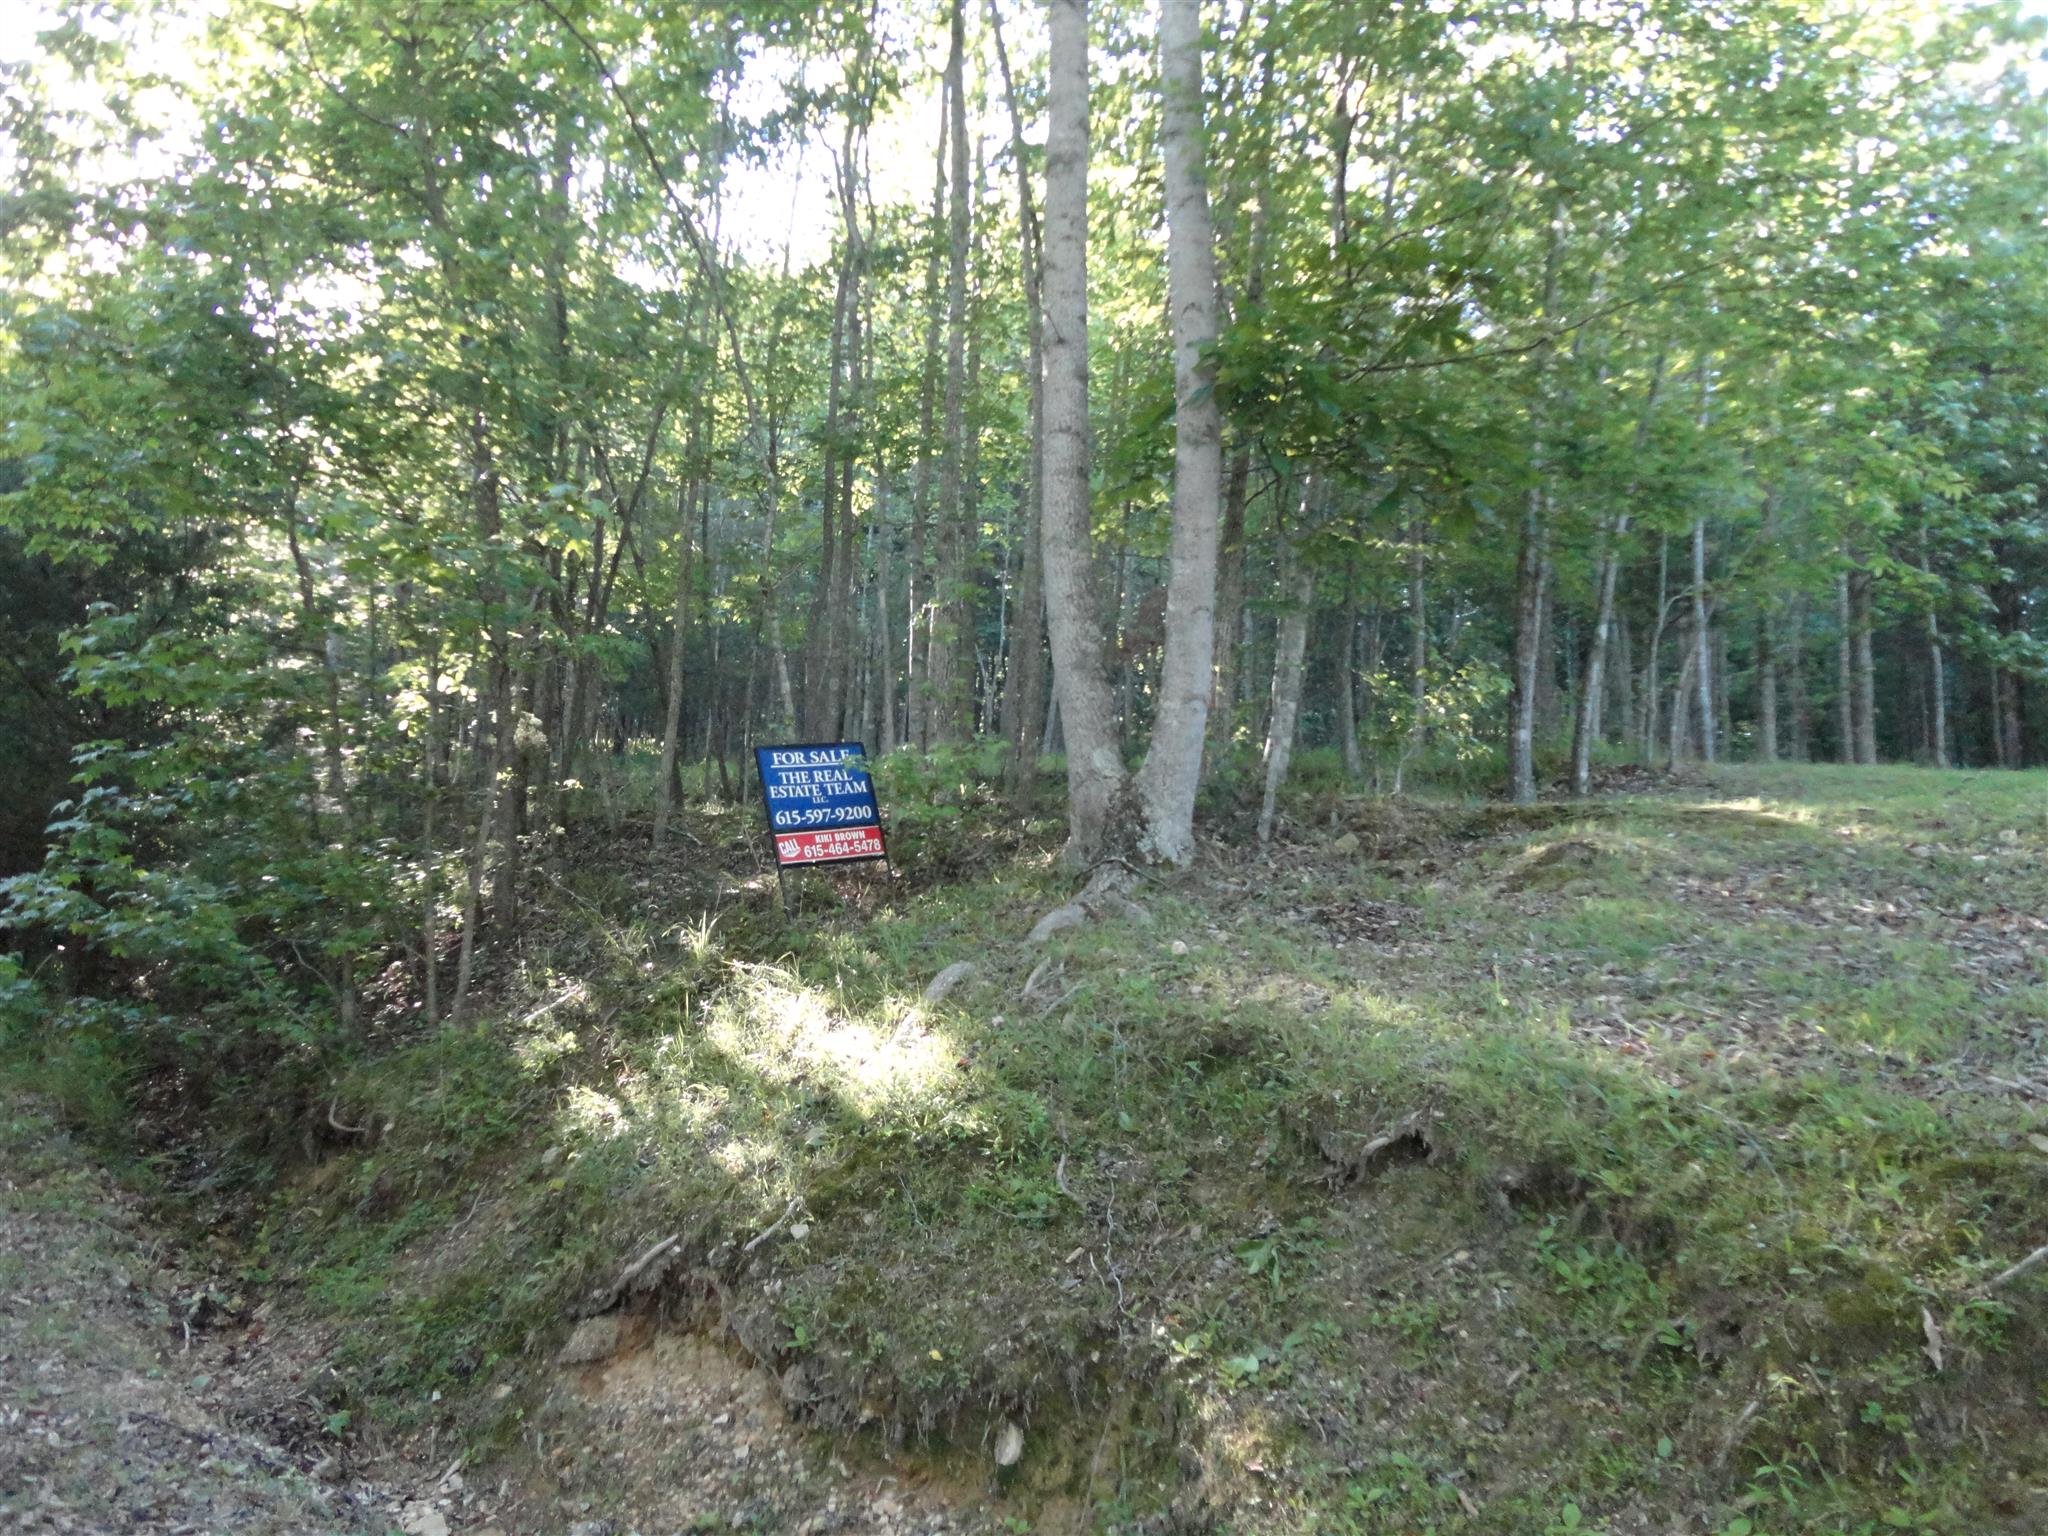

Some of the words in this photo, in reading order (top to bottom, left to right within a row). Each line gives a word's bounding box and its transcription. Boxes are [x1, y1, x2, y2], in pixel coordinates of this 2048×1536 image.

[772, 752, 806, 765] FOR
[810, 749, 851, 764] SALE
[778, 771, 811, 784] THE
[813, 769, 853, 782] REAL
[770, 784, 822, 798] ESTATE
[824, 781, 868, 796] TEAM
[775, 805, 872, 825] 615-597-9200
[834, 830, 865, 841] BROWN
[779, 838, 800, 853] CALL
[804, 838, 881, 857] 615-464-5478
